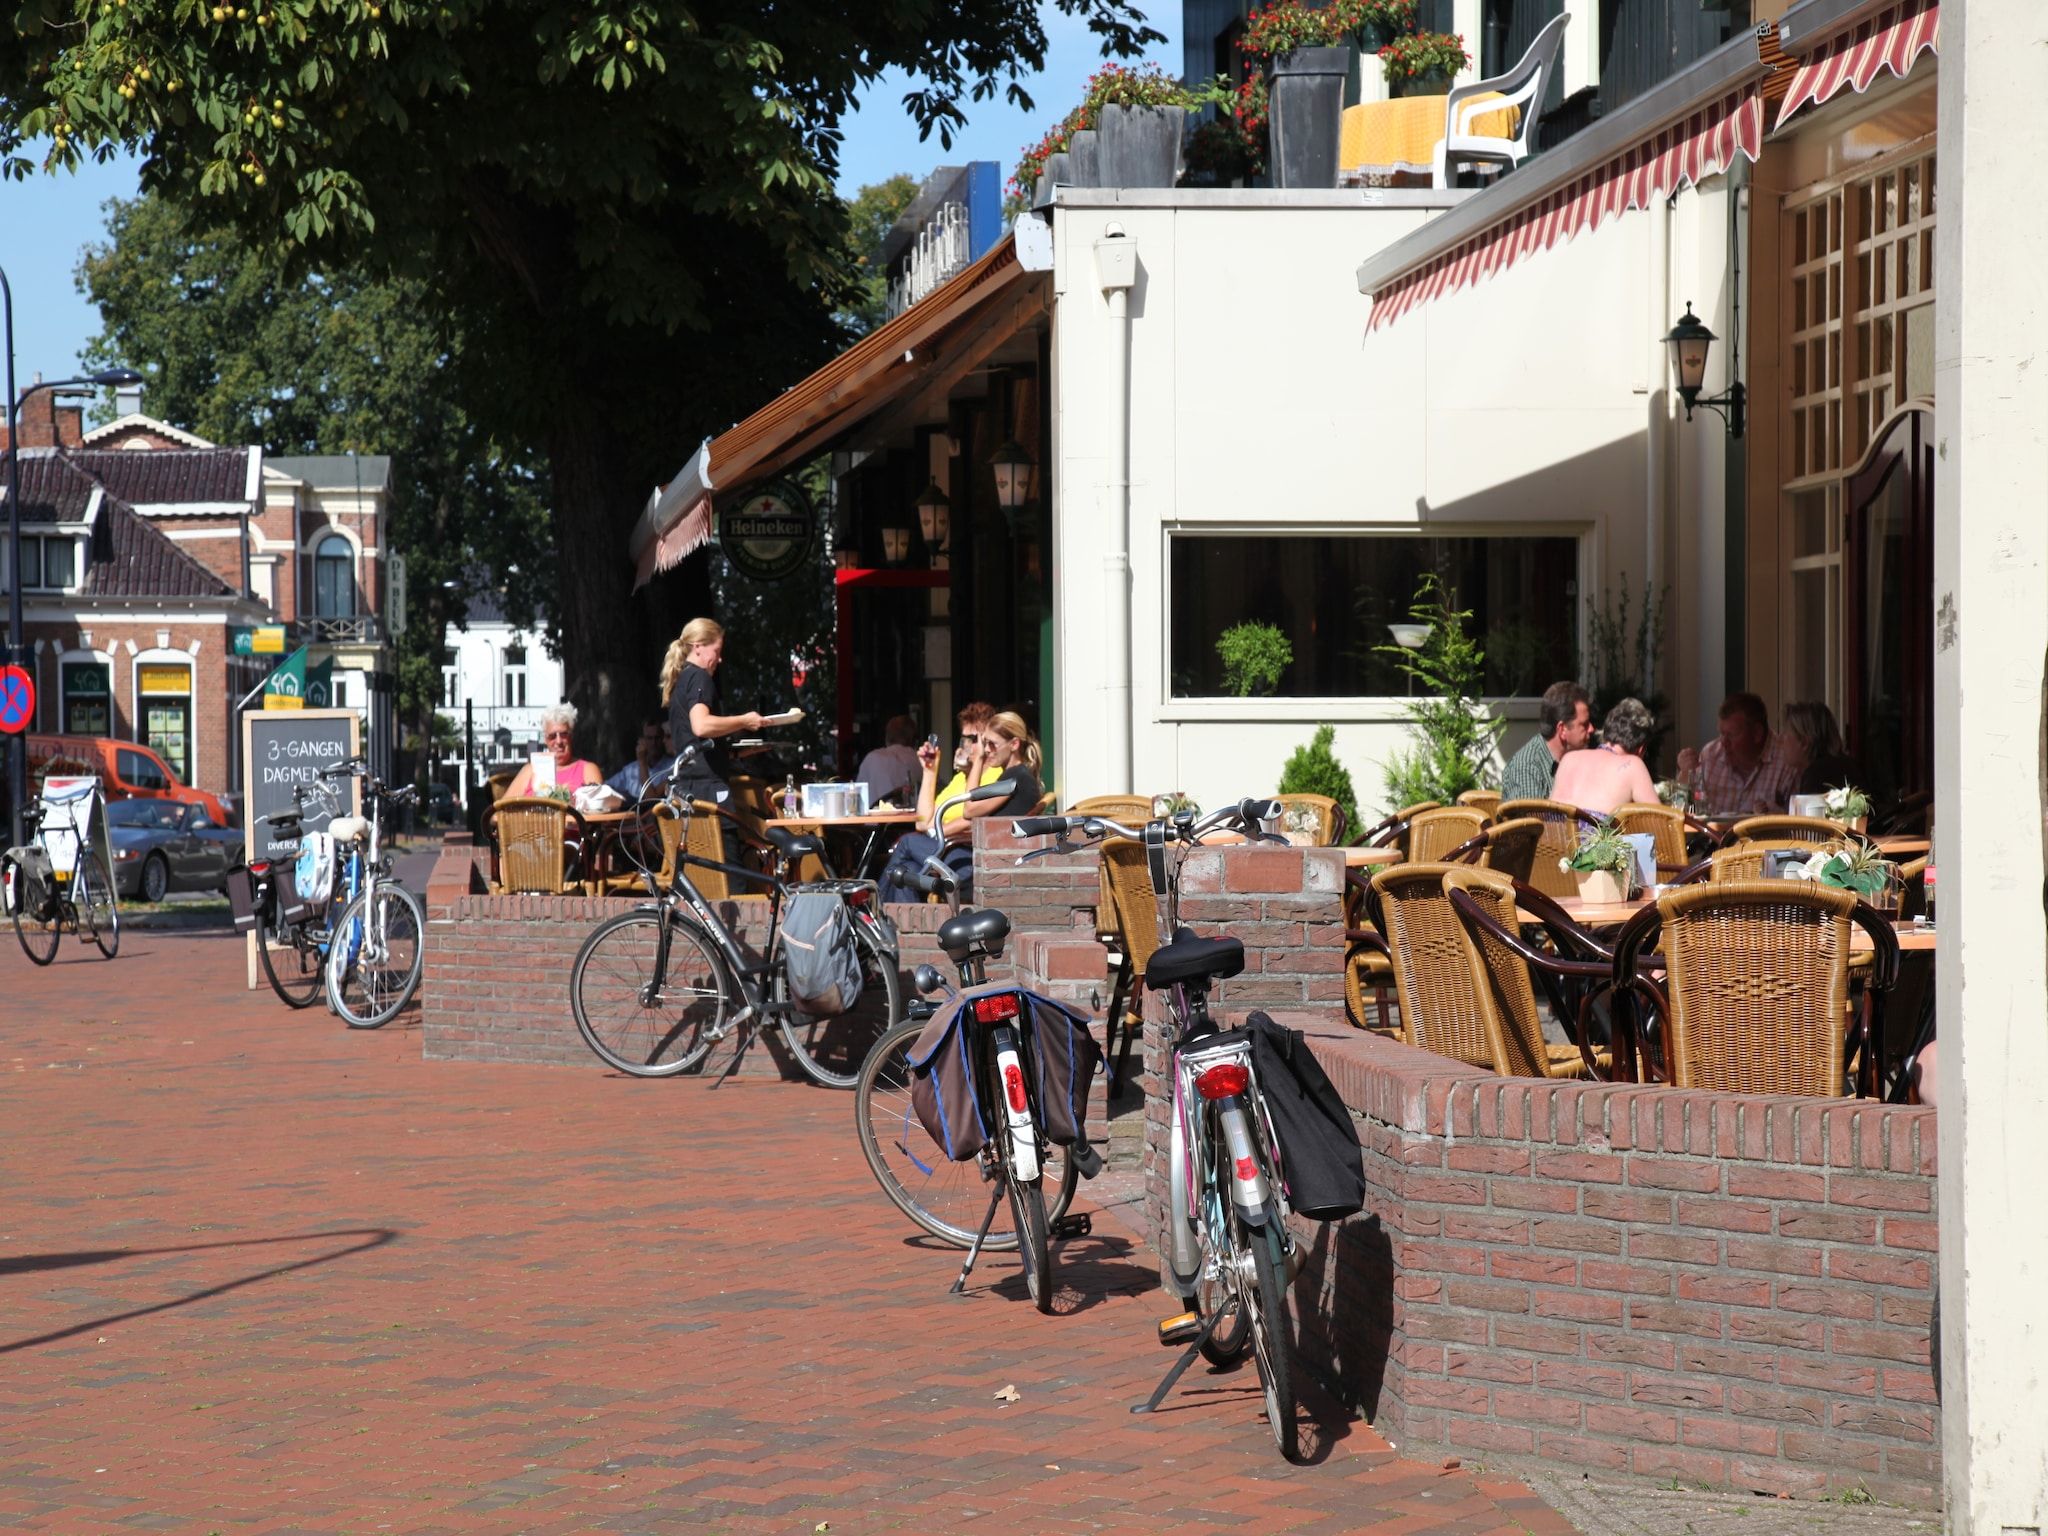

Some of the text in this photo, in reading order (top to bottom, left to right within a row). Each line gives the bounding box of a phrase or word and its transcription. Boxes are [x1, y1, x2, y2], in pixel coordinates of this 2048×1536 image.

[730, 519, 804, 536] Heineken
[267, 739, 345, 761] 3-GANGEN
[267, 840, 299, 852] DIVERSE
[691, 899, 726, 946] BATAVUS
